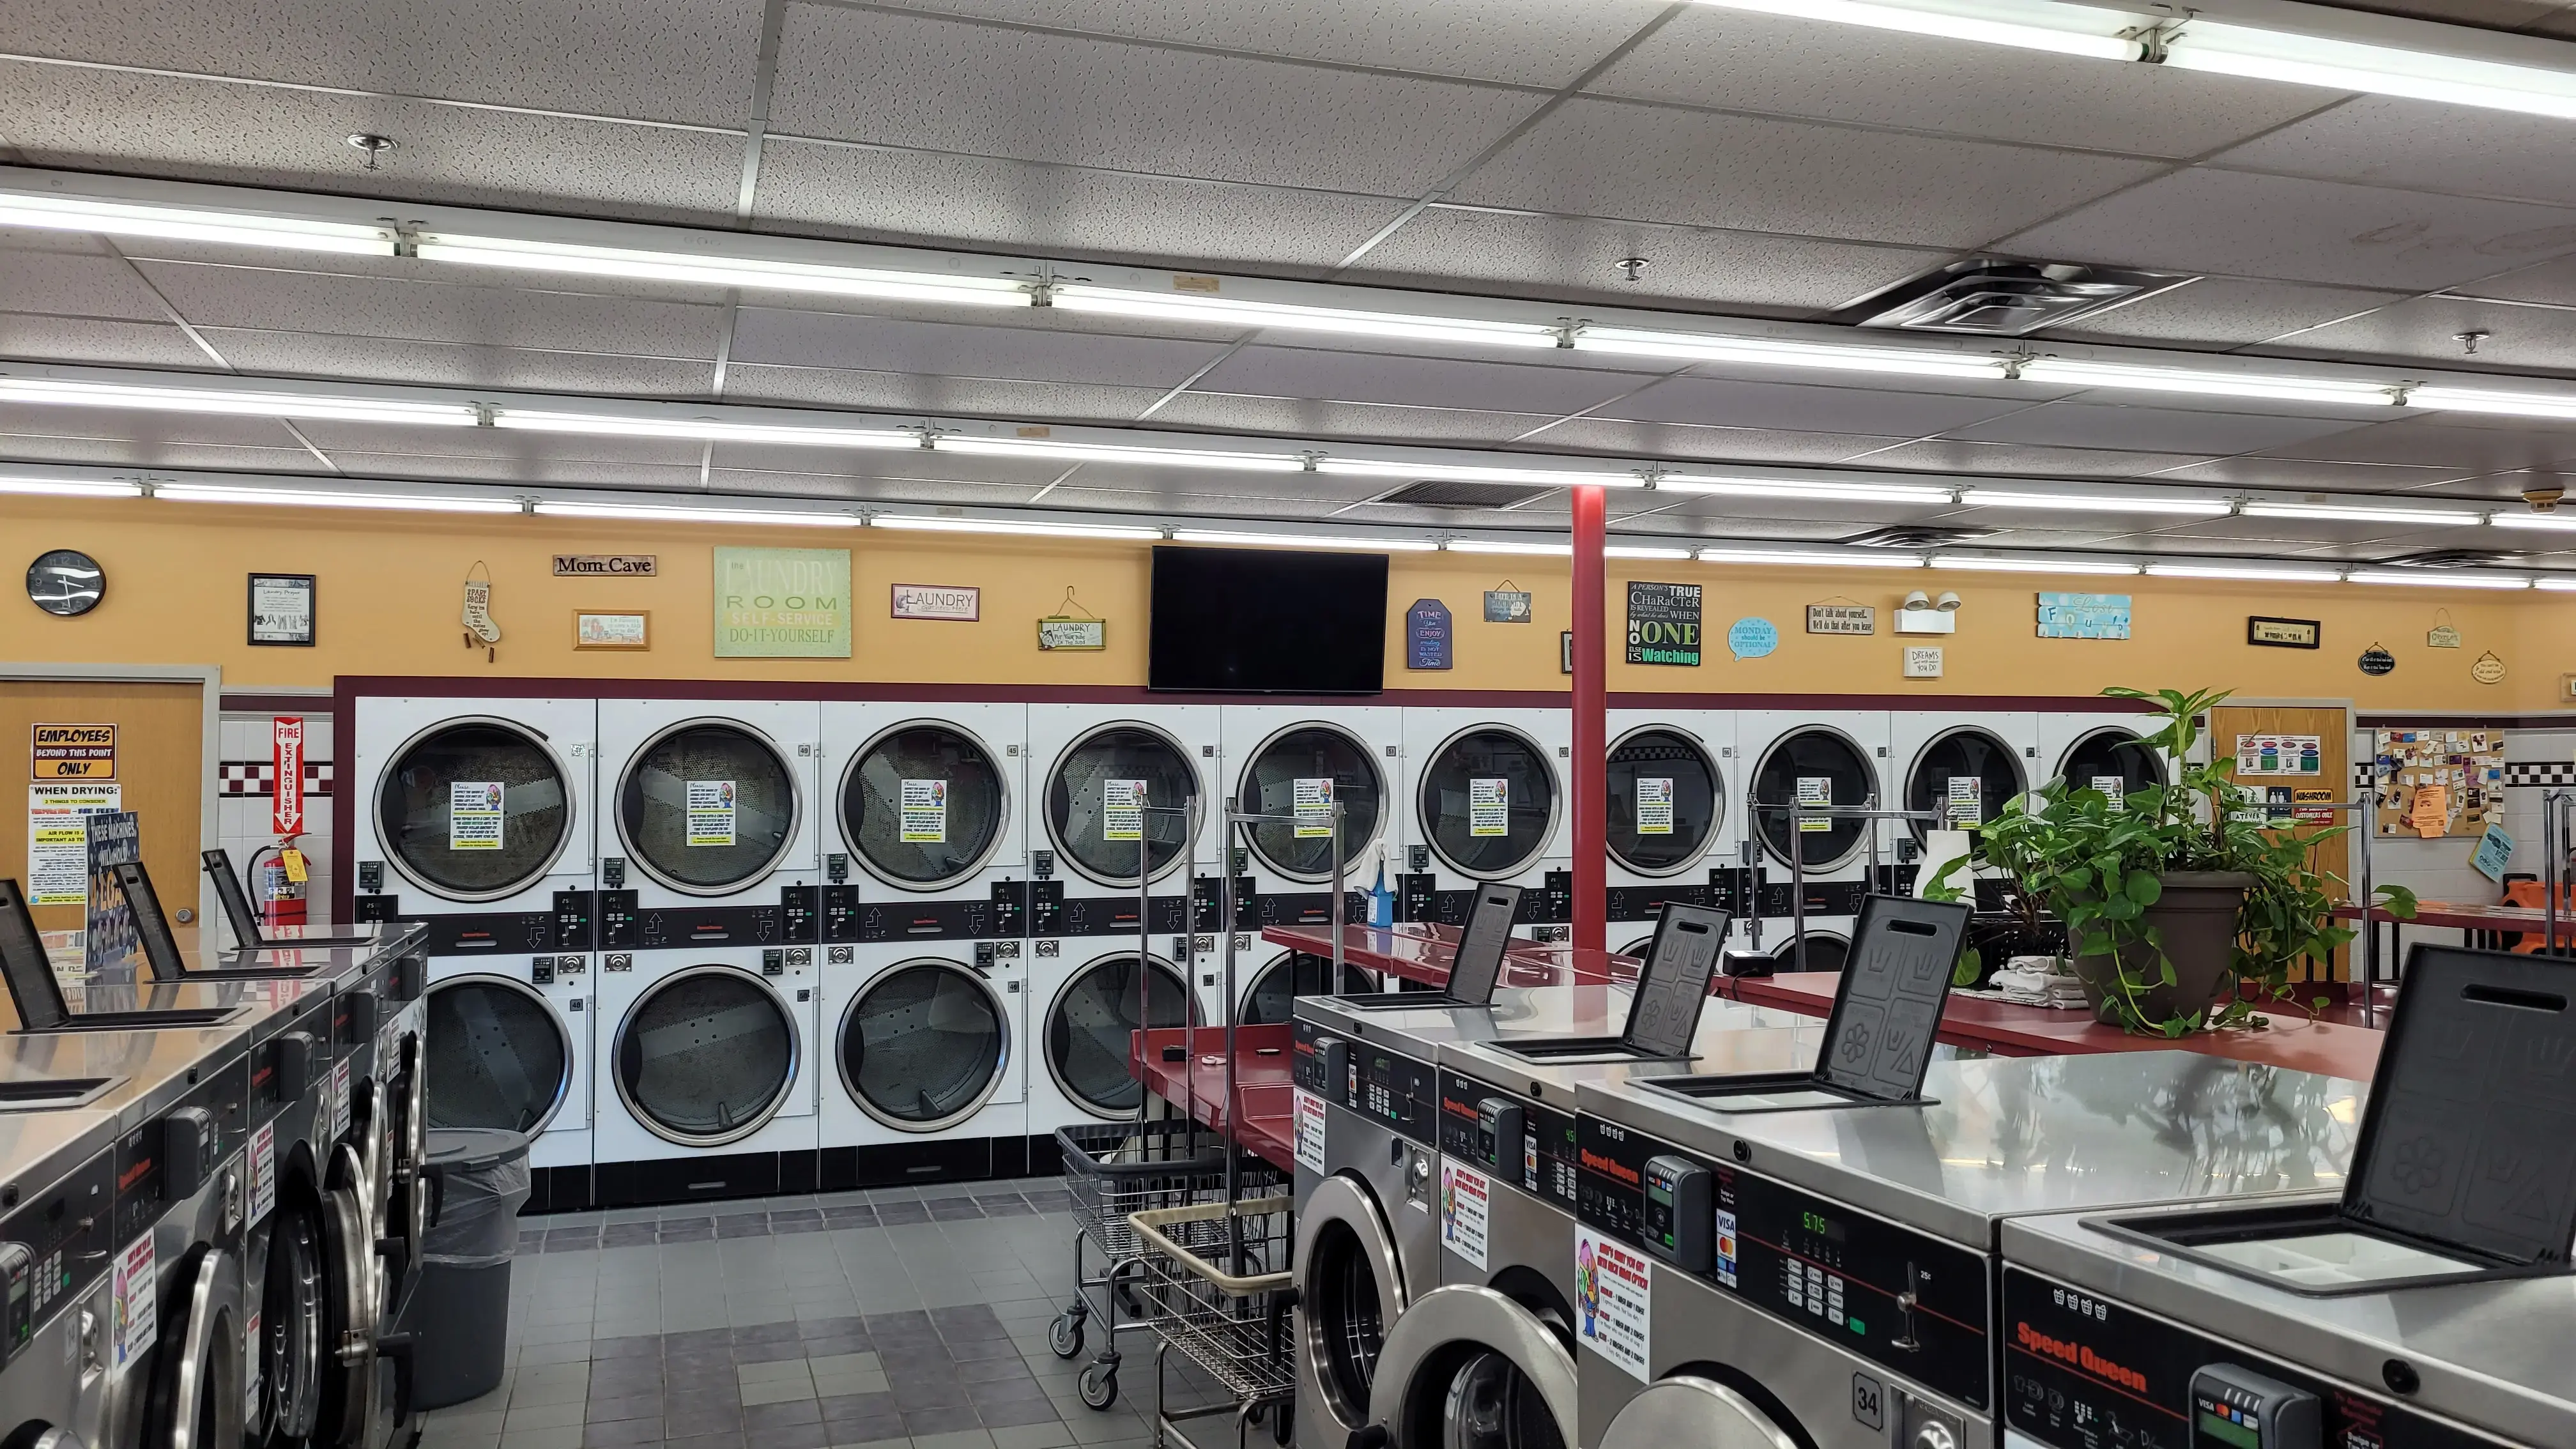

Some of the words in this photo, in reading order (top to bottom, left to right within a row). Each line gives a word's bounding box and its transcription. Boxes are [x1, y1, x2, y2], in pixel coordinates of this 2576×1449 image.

[556, 558, 604, 572] Mom
[609, 558, 652, 572] Cave
[732, 562, 744, 570] the
[35, 578, 42, 586] 9
[90, 579, 97, 588] 3
[725, 559, 837, 595] LAUNDRY
[907, 590, 974, 607] LAUNDRY
[1669, 586, 1700, 597] TRUE
[726, 596, 837, 610] ROOM
[2073, 596, 2114, 613] Lost
[1670, 611, 1699, 620] WHEN
[1813, 608, 1823, 617] Don't
[1825, 608, 1834, 617] talk
[1835, 609, 1846, 618] about
[1053, 624, 1090, 632] LAUNDRY
[1813, 620, 1822, 629] We'll
[1824, 621, 1829, 629] do
[1841, 621, 1850, 630] after
[730, 629, 834, 643] DO-IT-YOURSELF
[1642, 621, 1699, 645] ONE
[1642, 648, 1699, 664] Watching
[1912, 651, 1938, 660] DREAMS
[38, 730, 110, 742] EMPLOYEES
[278, 728, 299, 739] FIRE
[57, 762, 91, 775] ONLY
[2296, 792, 2331, 801] WASHROOM
[91, 824, 107, 843] THESE
[113, 844, 128, 862] HOLD
[100, 870, 126, 911] LOA
[1526, 1139, 1536, 1150] VISA
[1581, 1148, 1609, 1171] Speed
[1609, 1159, 1638, 1184] Queen
[1717, 1215, 1735, 1232] VISA
[1804, 1212, 1825, 1234] 5.75
[2018, 1322, 2078, 1363] Speed
[2080, 1346, 2147, 1393] Queen
[1858, 1387, 1878, 1416] 34
[2199, 1398, 2214, 1412] VISA
